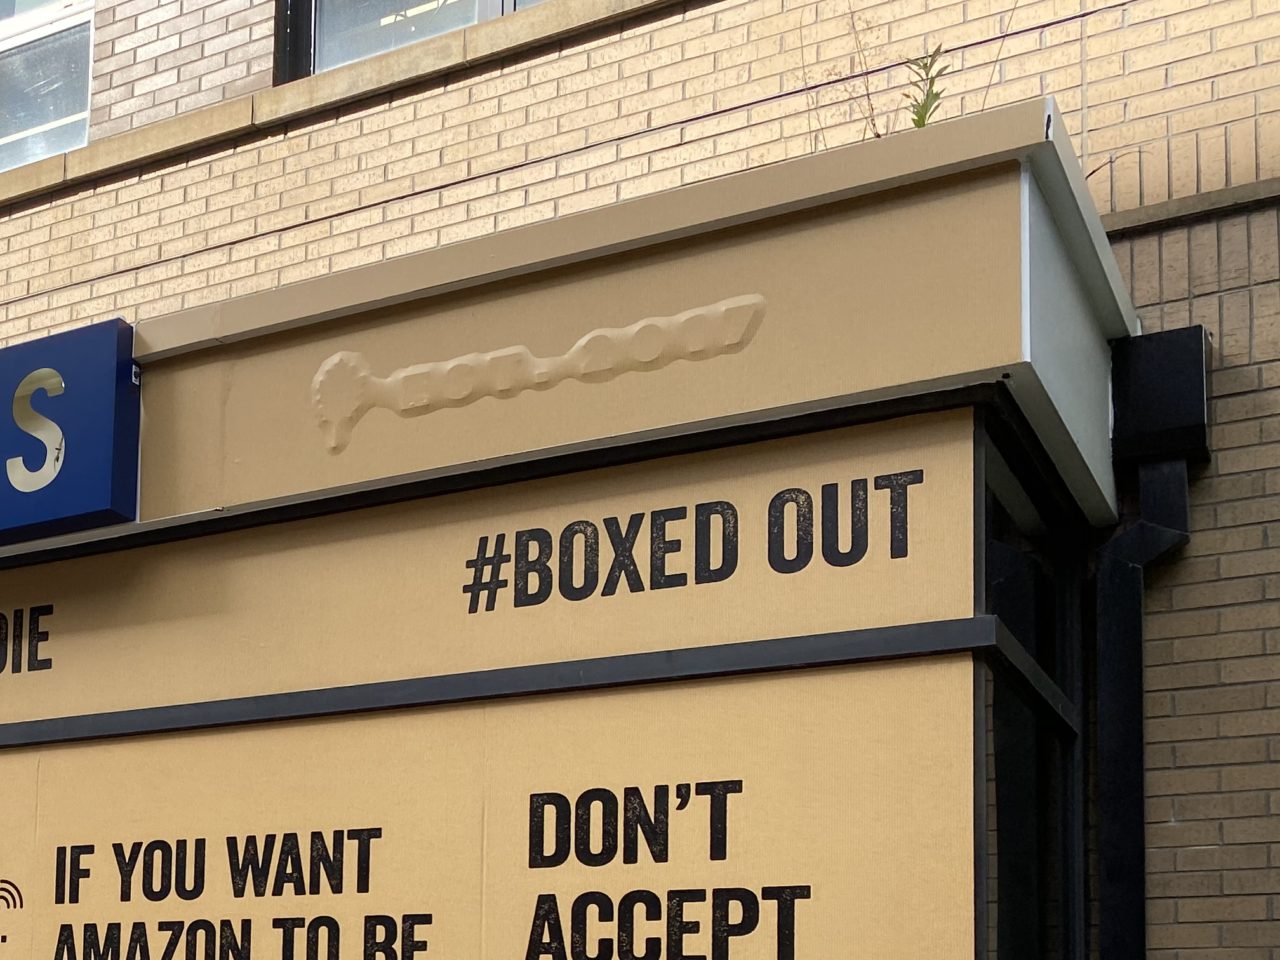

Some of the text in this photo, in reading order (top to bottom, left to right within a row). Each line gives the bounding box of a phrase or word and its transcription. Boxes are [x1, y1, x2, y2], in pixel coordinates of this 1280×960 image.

[461, 468, 924, 616] #BOXED OUT
[54, 826, 383, 904] IF YOU WANT
[527, 779, 744, 868] DON'T
